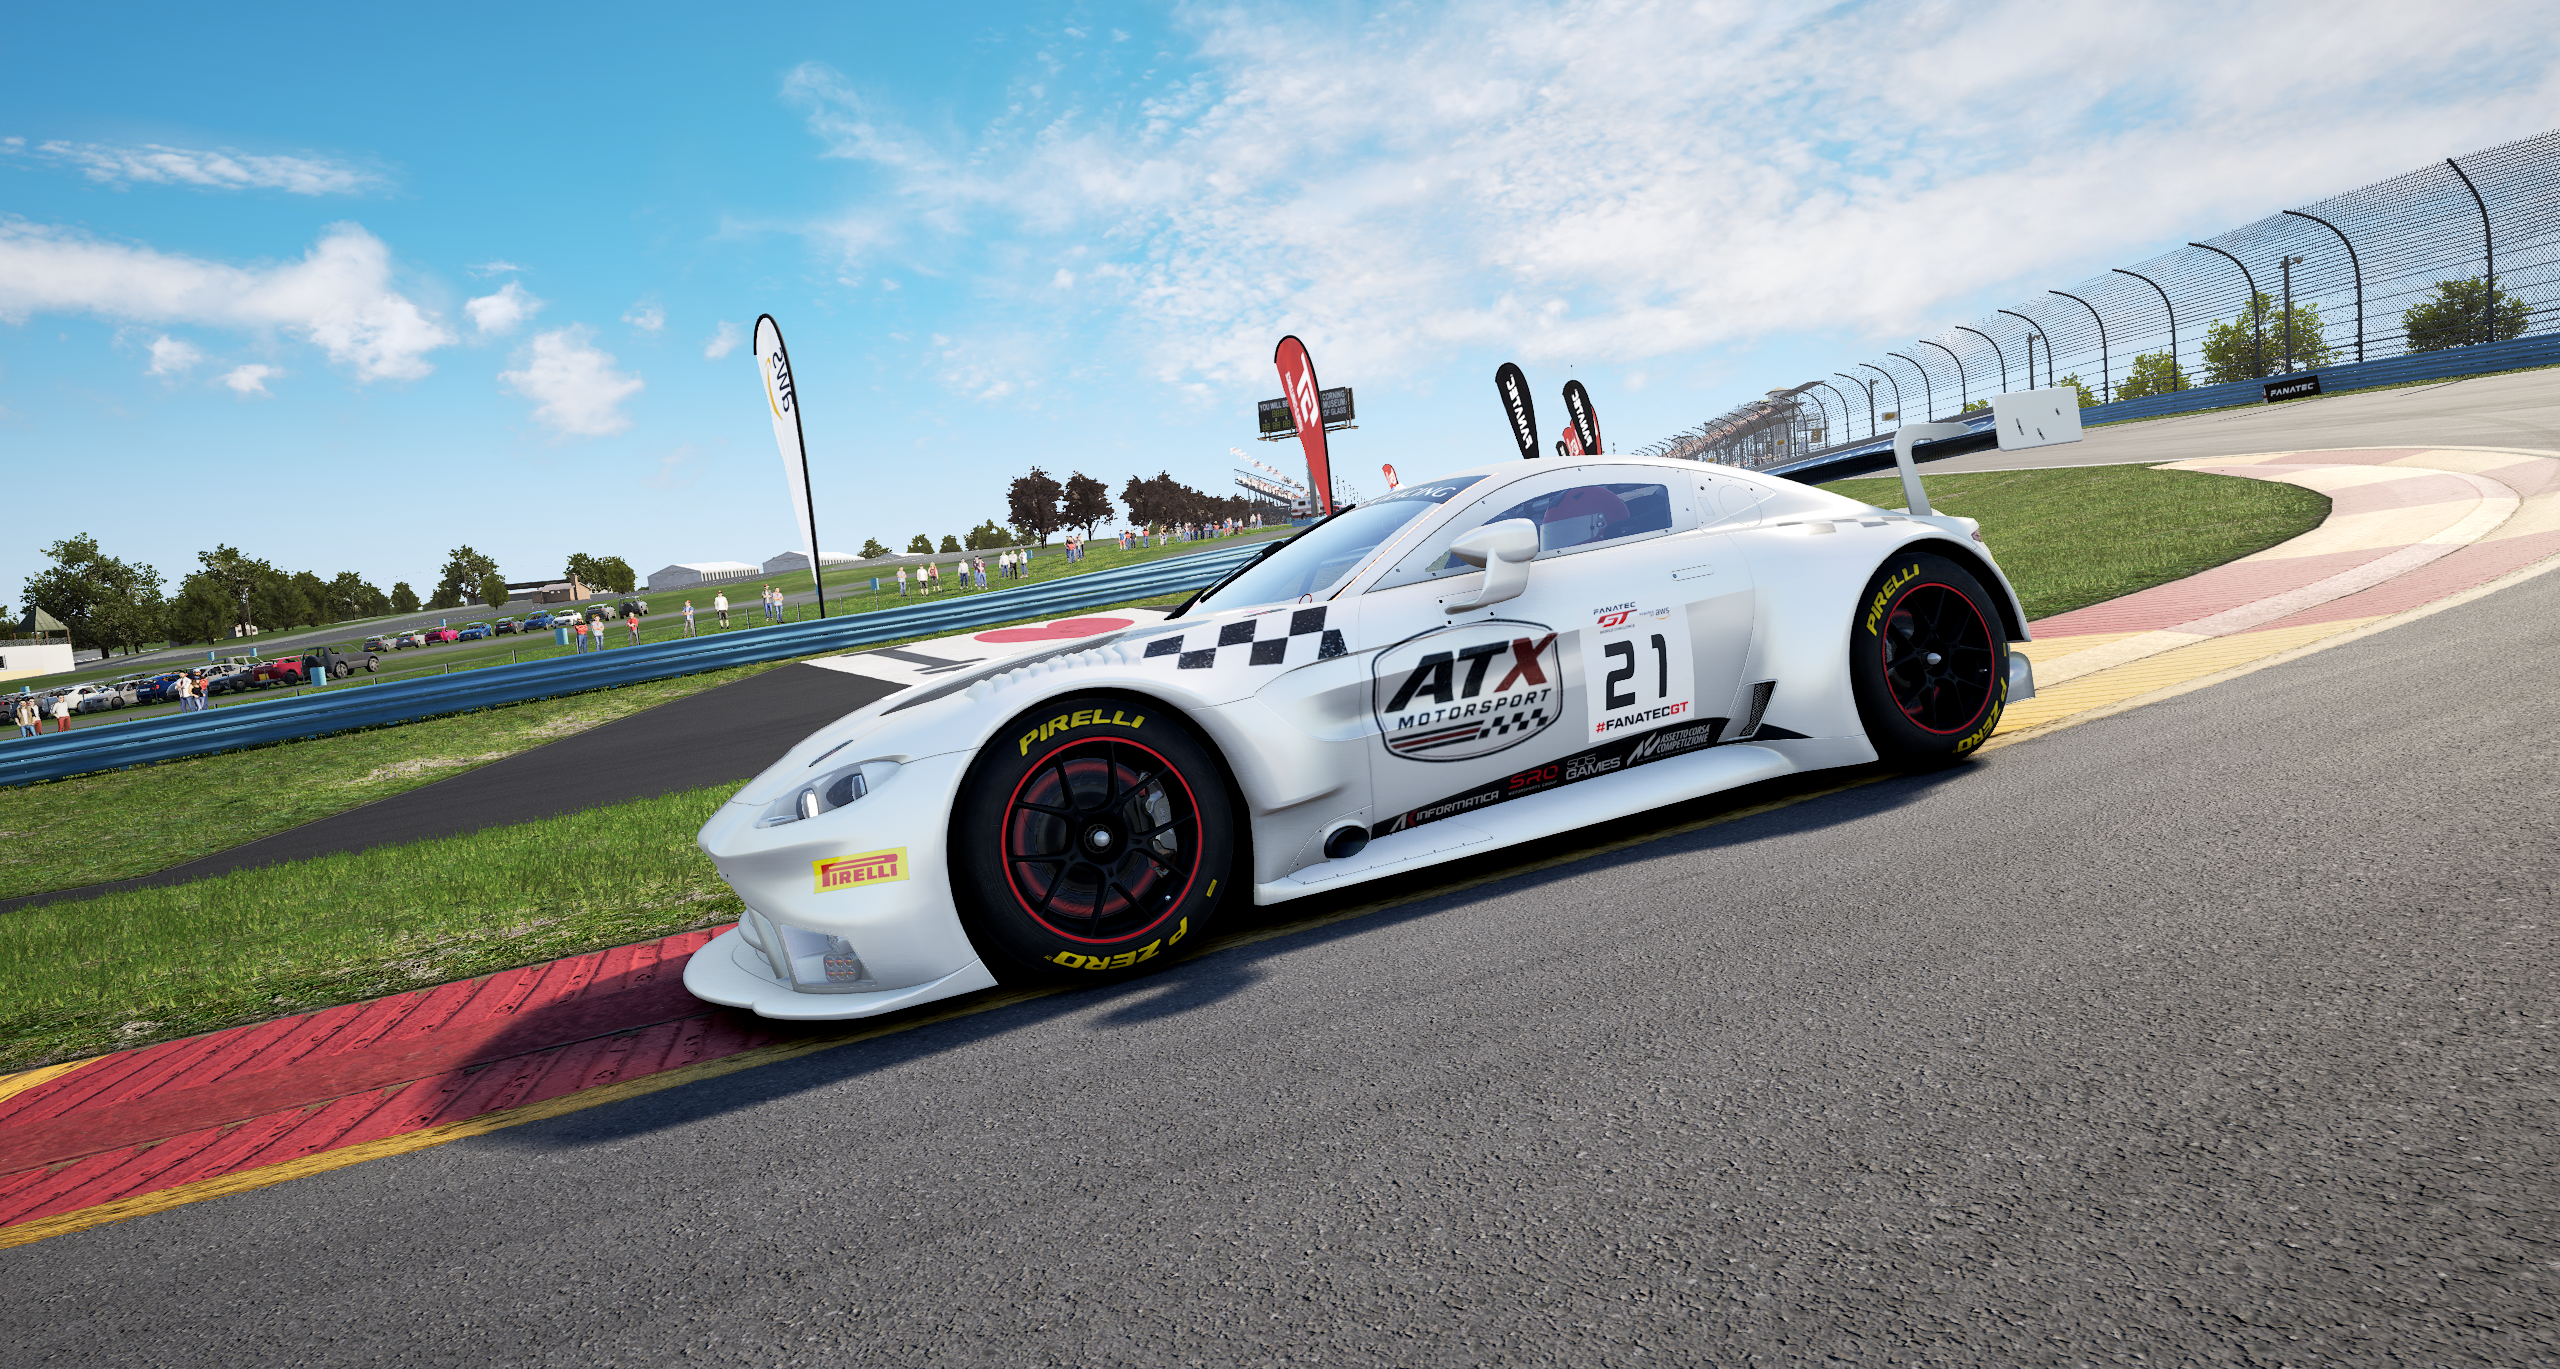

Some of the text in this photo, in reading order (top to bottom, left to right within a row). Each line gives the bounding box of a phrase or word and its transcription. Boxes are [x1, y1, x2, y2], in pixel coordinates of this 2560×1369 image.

[1322, 390, 1345, 400] CORNING
[2270, 382, 2314, 397] FANATEC
[1260, 403, 1270, 412] YOU
[1270, 401, 1282, 409] WILL
[1322, 398, 1346, 408] MUSEUM
[1331, 407, 1347, 415] GLASS
[1593, 601, 1636, 615] FANATEC
[1655, 607, 1670, 616] aws
[1866, 563, 1920, 636] PIRELLI
[1597, 609, 1638, 628] GT
[1384, 632, 1558, 713] ATX
[1604, 633, 1668, 711] 21
[1398, 688, 1552, 730] MOTORSPORT
[1596, 701, 1689, 733] #FANATECGT
[1956, 676, 2007, 753] P ZERO
[1018, 709, 1146, 756] PIRELLI
[1657, 733, 1708, 753] COMPETIZIONE
[1660, 724, 1711, 744] ASSETTO CORSA
[1509, 765, 1559, 790] SRO
[1566, 757, 1621, 780] GAMES
[1416, 790, 1500, 821] INFORMATICA
[821, 853, 898, 888] PIRELLI
[1052, 916, 1188, 970] P ZERO
